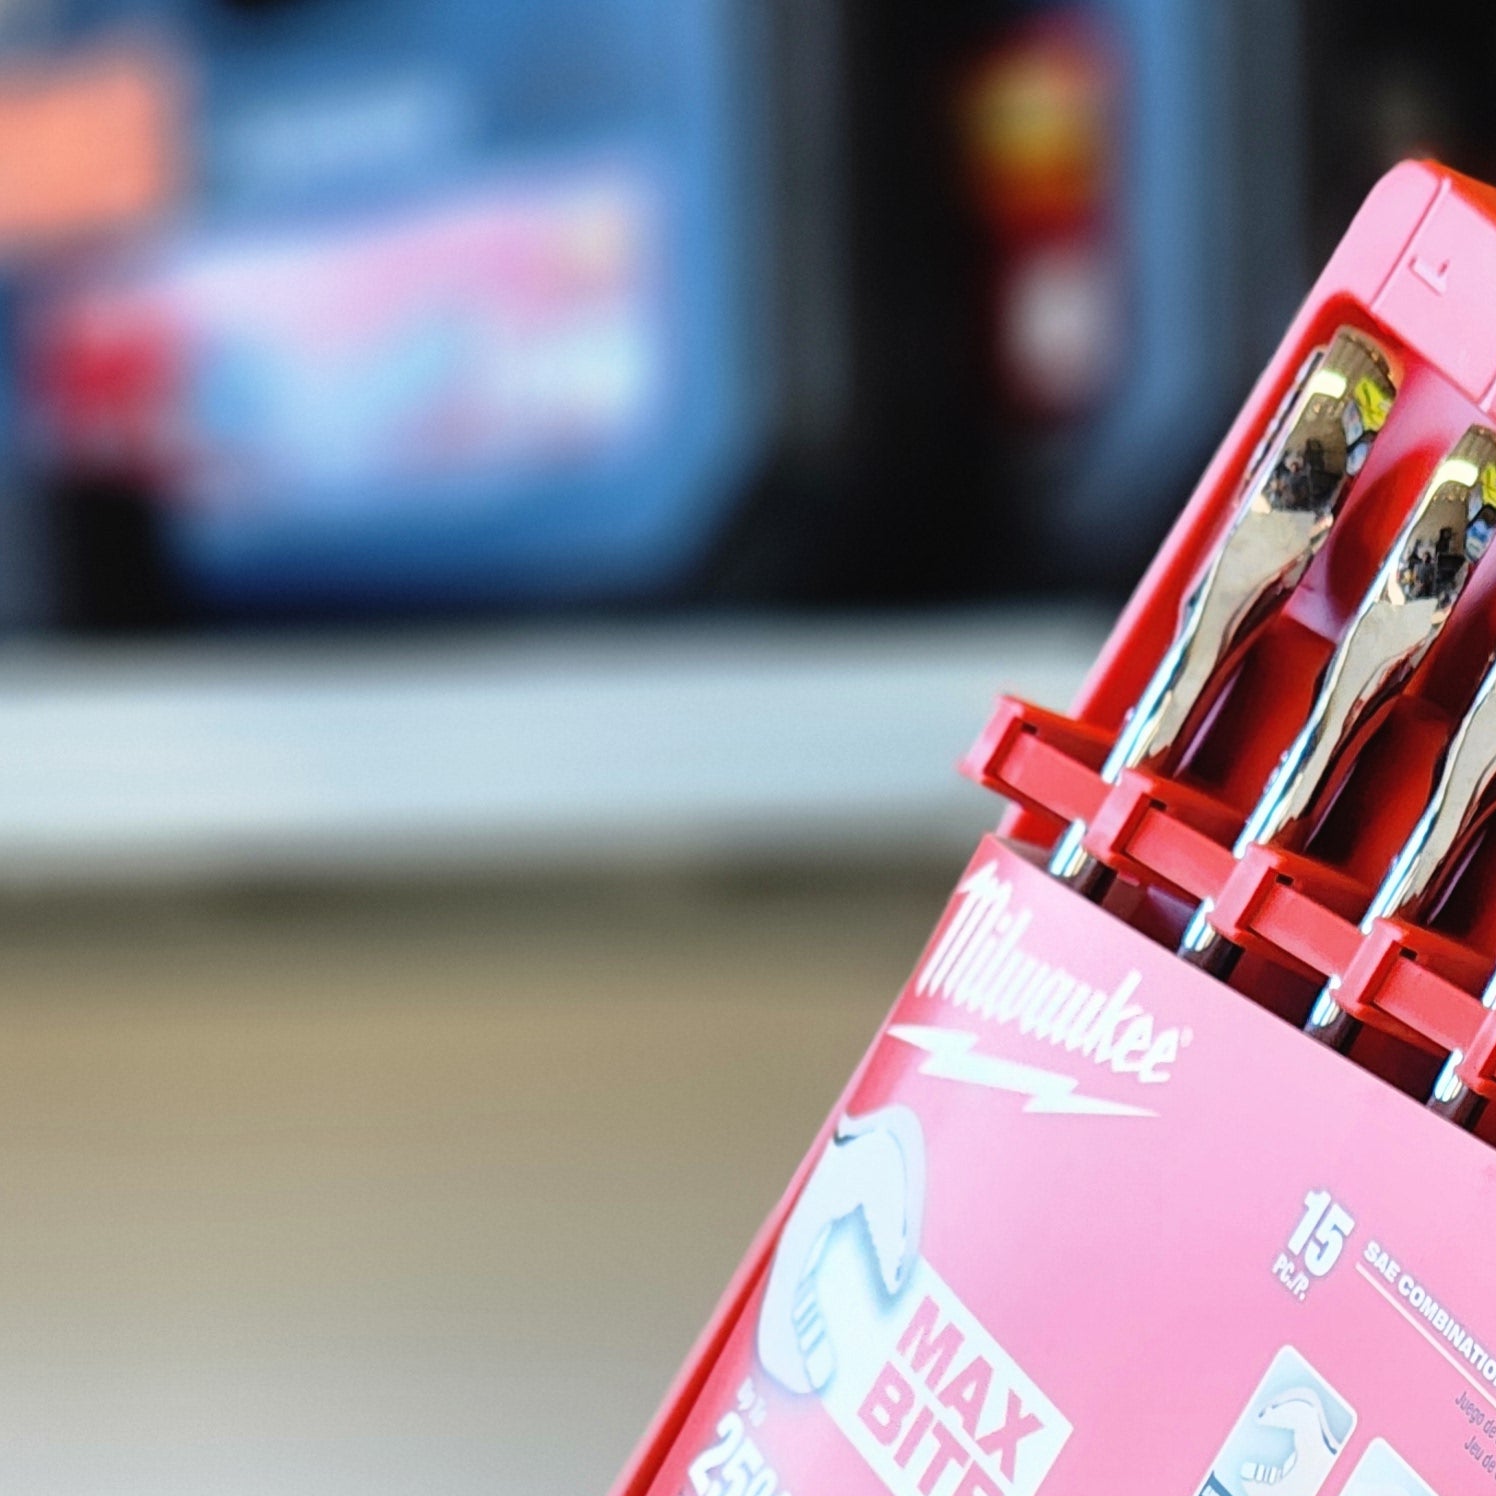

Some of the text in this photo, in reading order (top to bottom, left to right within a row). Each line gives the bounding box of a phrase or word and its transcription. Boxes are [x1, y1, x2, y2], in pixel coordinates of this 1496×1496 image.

[914, 860, 1181, 1084] Milwaukee
[1288, 1189, 1356, 1278] 15
[1363, 1240, 1399, 1284] SAE
[896, 1294, 1045, 1485] MAX
[1455, 1390, 1486, 1426] Juego
[1464, 1435, 1484, 1462] Jeu
[1482, 1454, 1496, 1474] de
